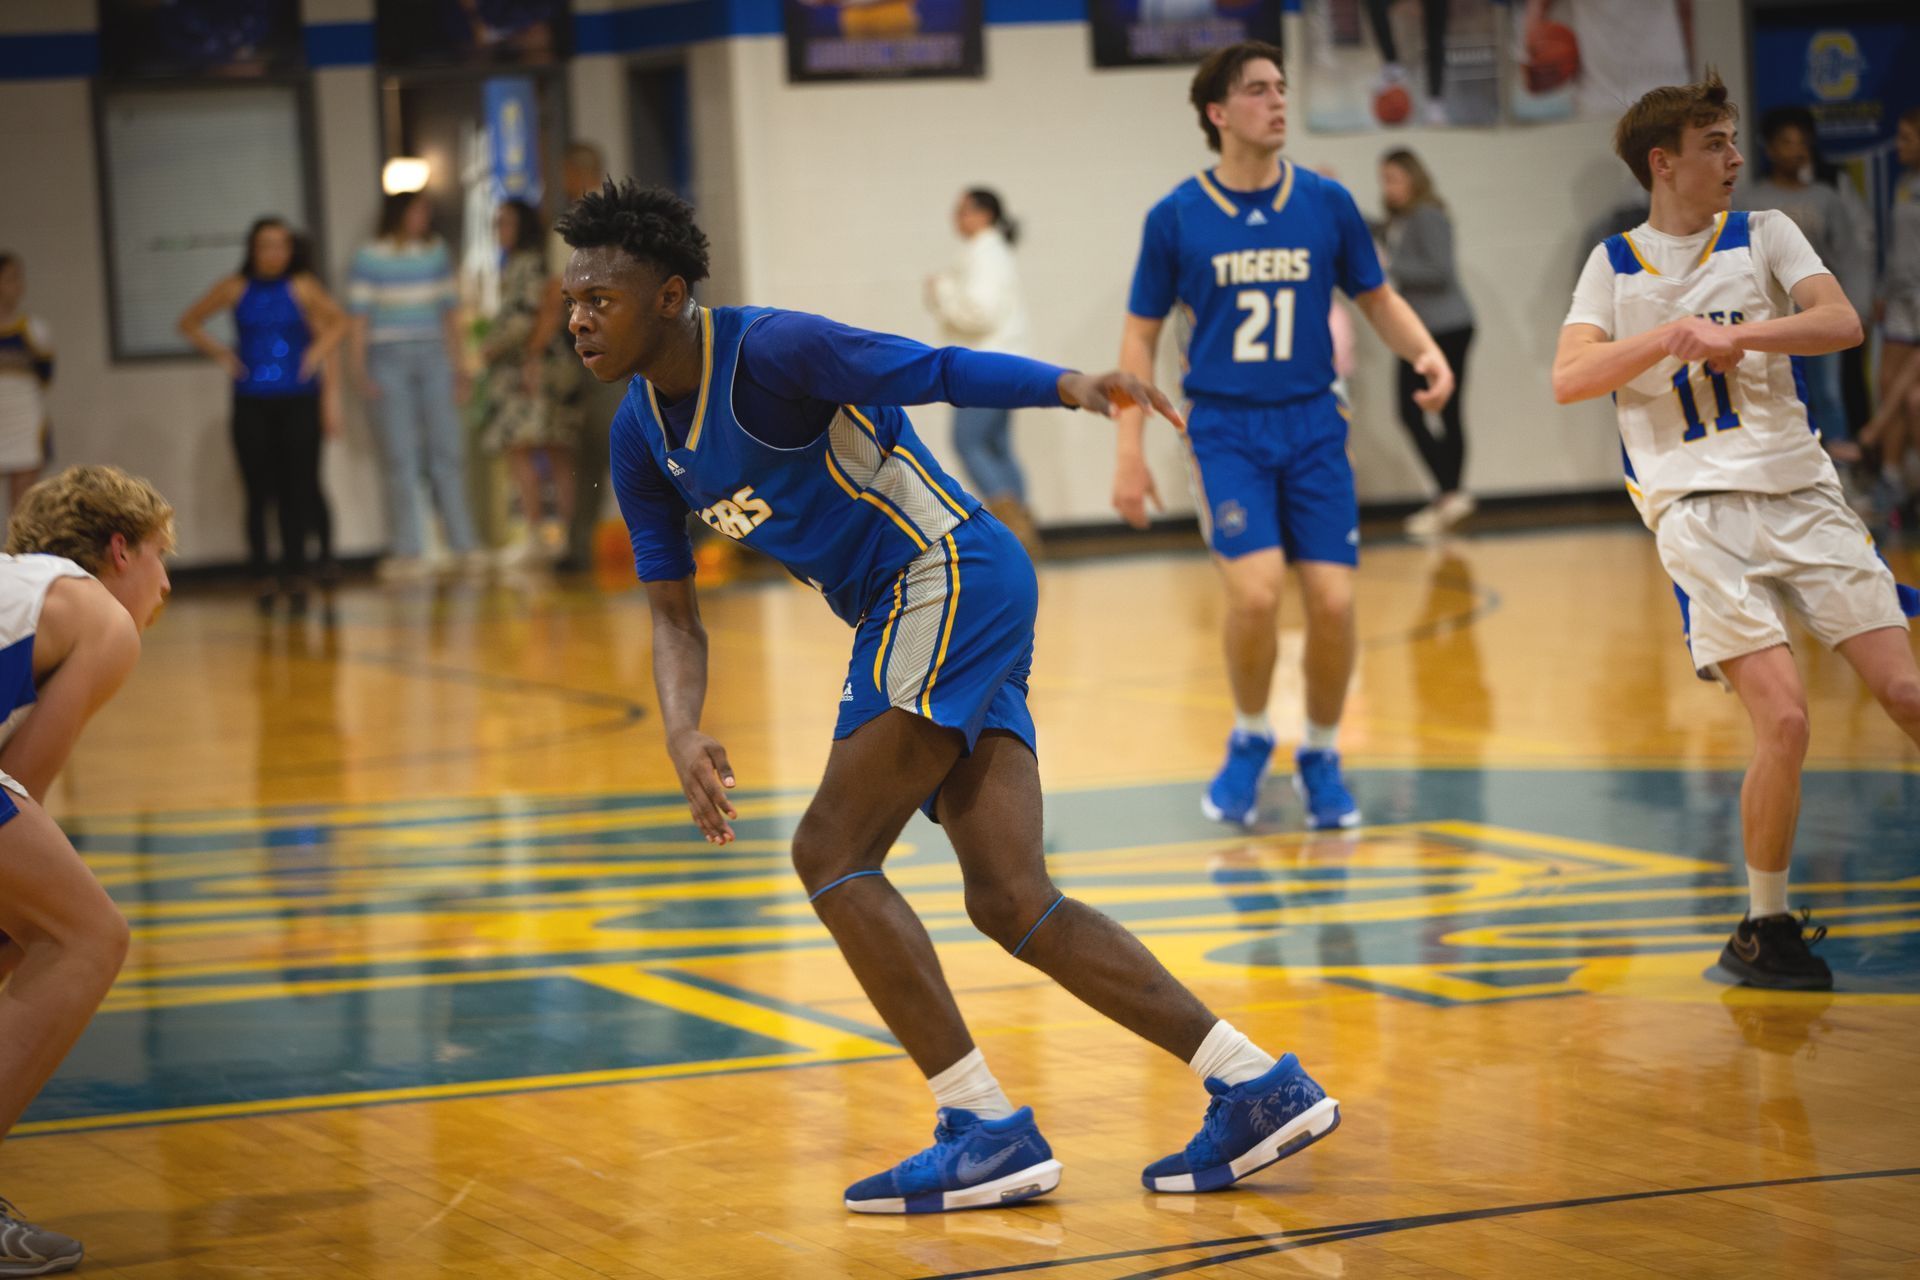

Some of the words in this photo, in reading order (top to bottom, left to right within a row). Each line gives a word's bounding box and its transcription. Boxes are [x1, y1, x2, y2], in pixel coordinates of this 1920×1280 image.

[1211, 248, 1311, 287] TIGERS
[1232, 288, 1296, 363] 21
[1671, 359, 1742, 443] 11
